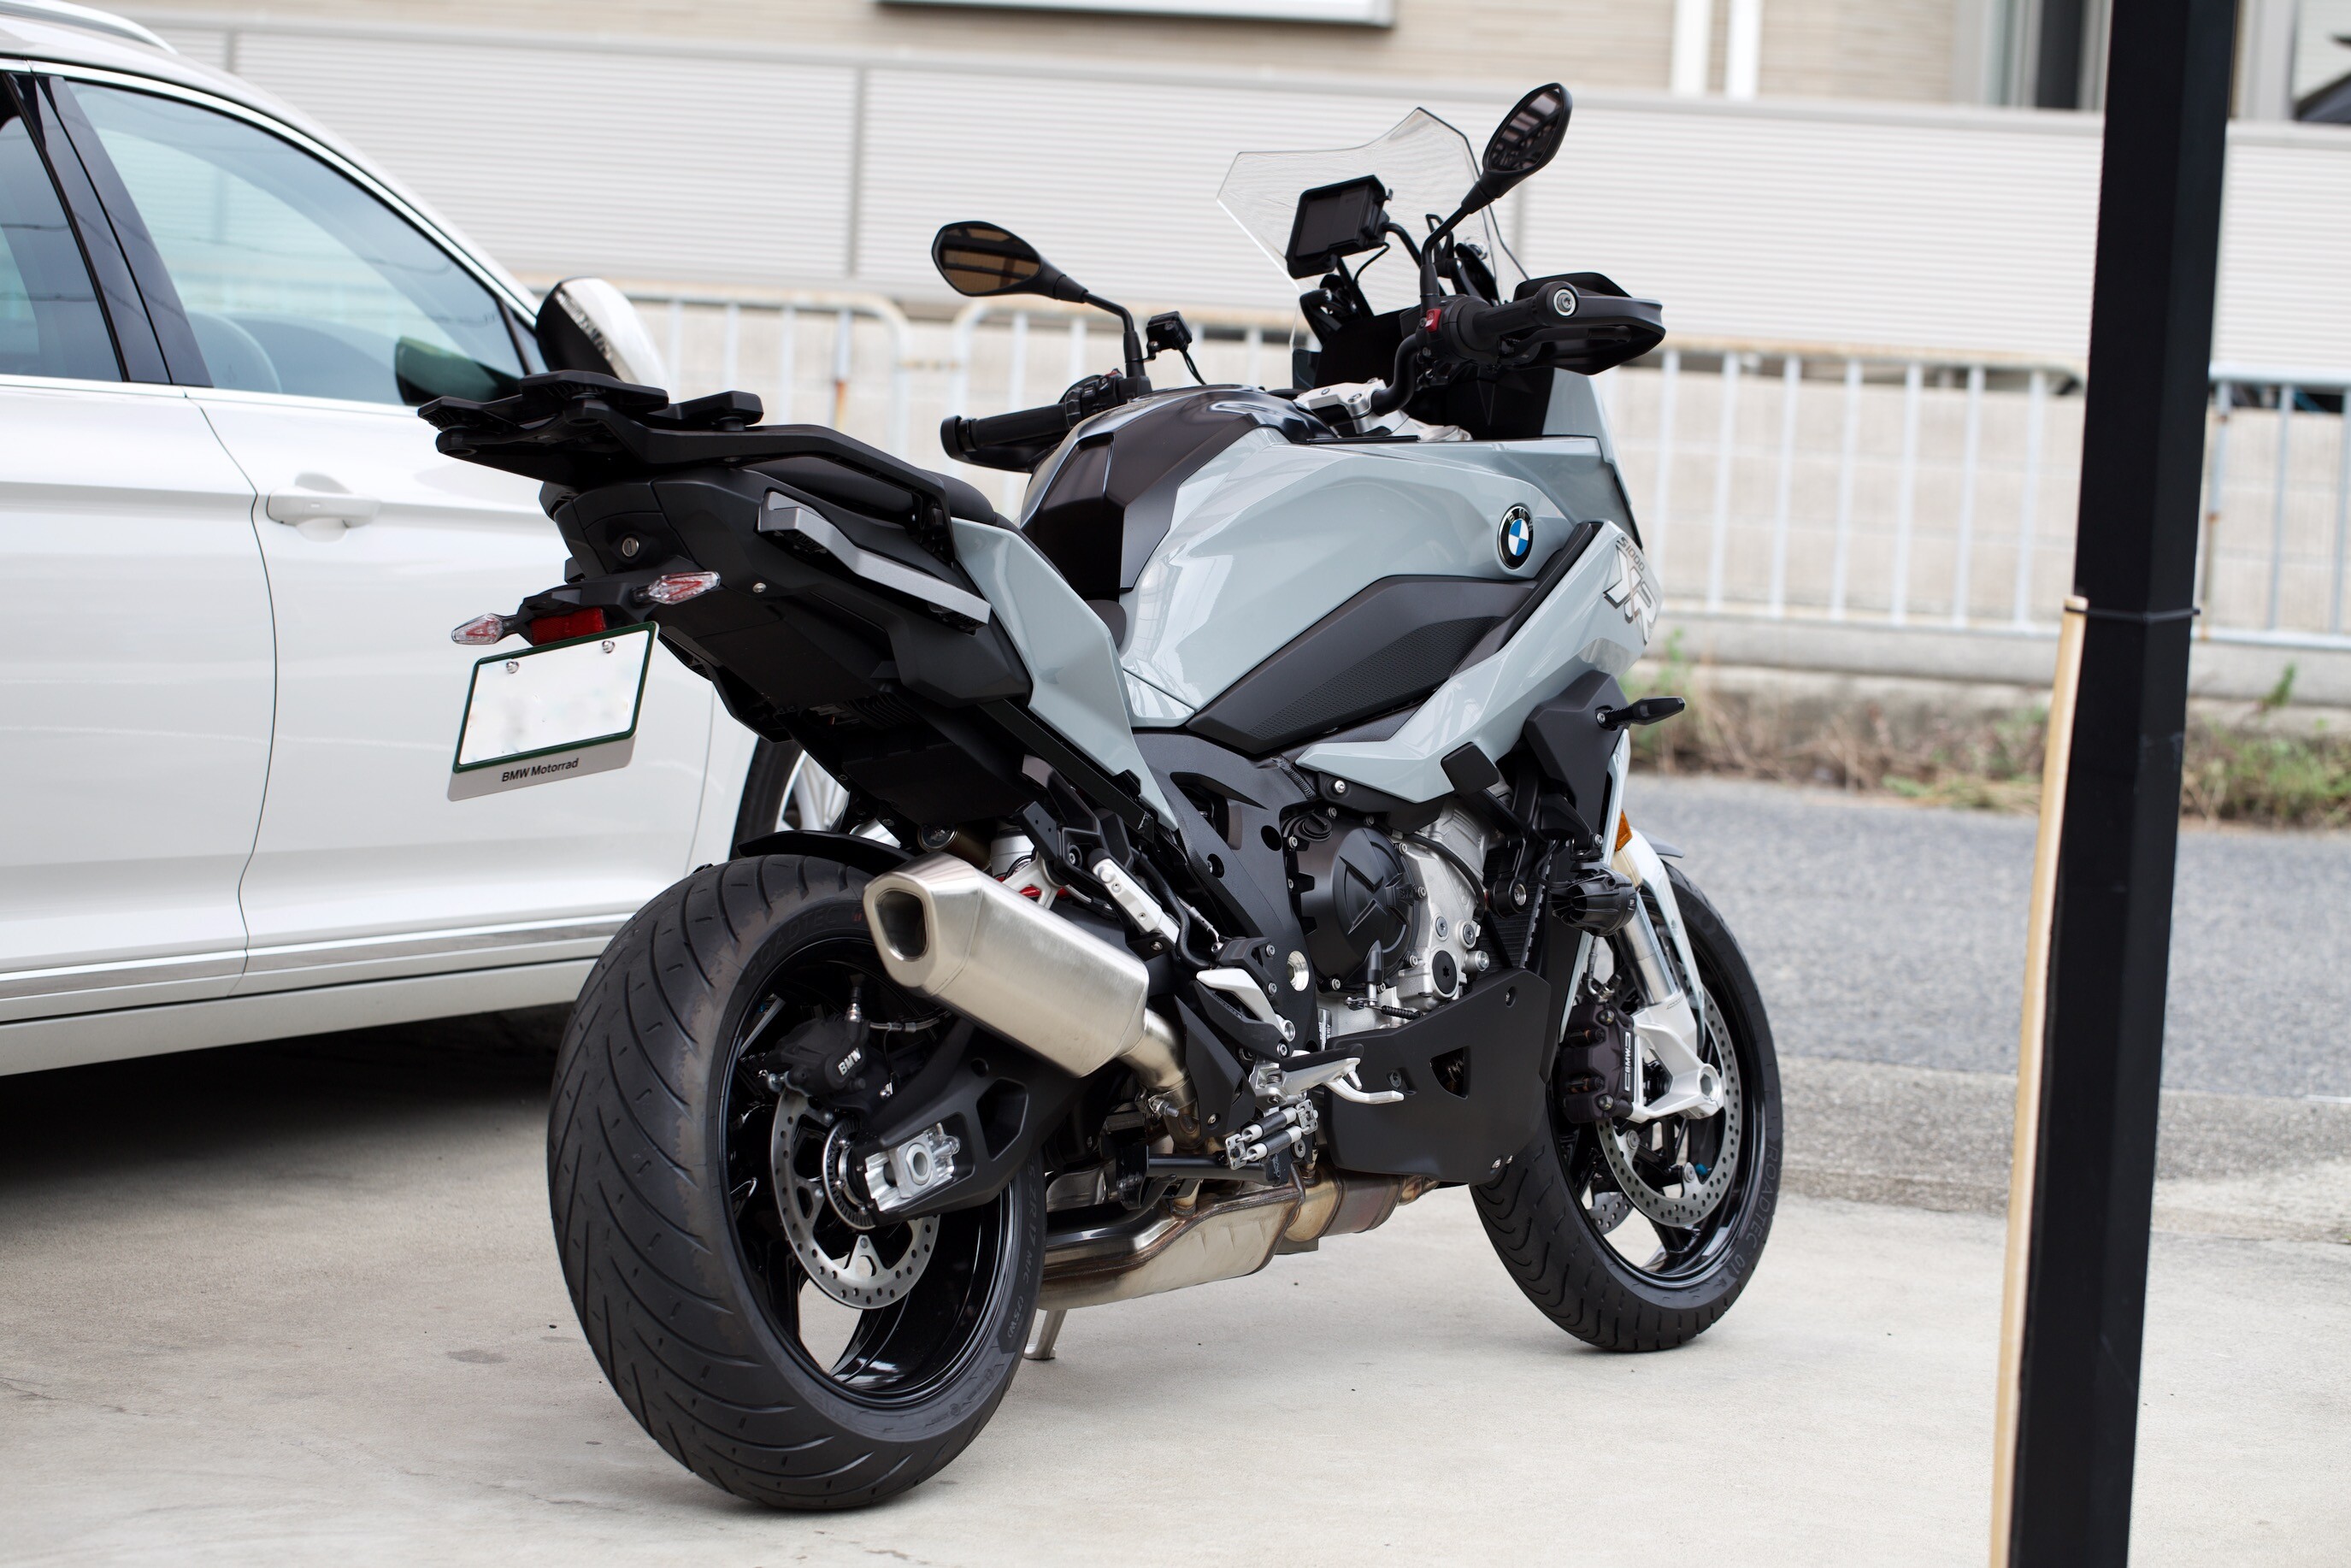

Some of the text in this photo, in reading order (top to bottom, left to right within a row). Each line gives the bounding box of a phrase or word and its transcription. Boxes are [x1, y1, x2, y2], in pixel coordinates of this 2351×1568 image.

[1507, 508, 1533, 531] BMW
[1603, 544, 1658, 646] XR
[502, 757, 579, 782] BMW Motorrad
[838, 1047, 861, 1076] BMW
[1028, 1183, 1037, 1218] ZR
[1729, 1144, 1779, 1275] ROADTEC 01
[1028, 1223, 1037, 1247] 17
[1022, 1249, 1033, 1285] M/C
[1007, 1295, 1024, 1339] (75W)
